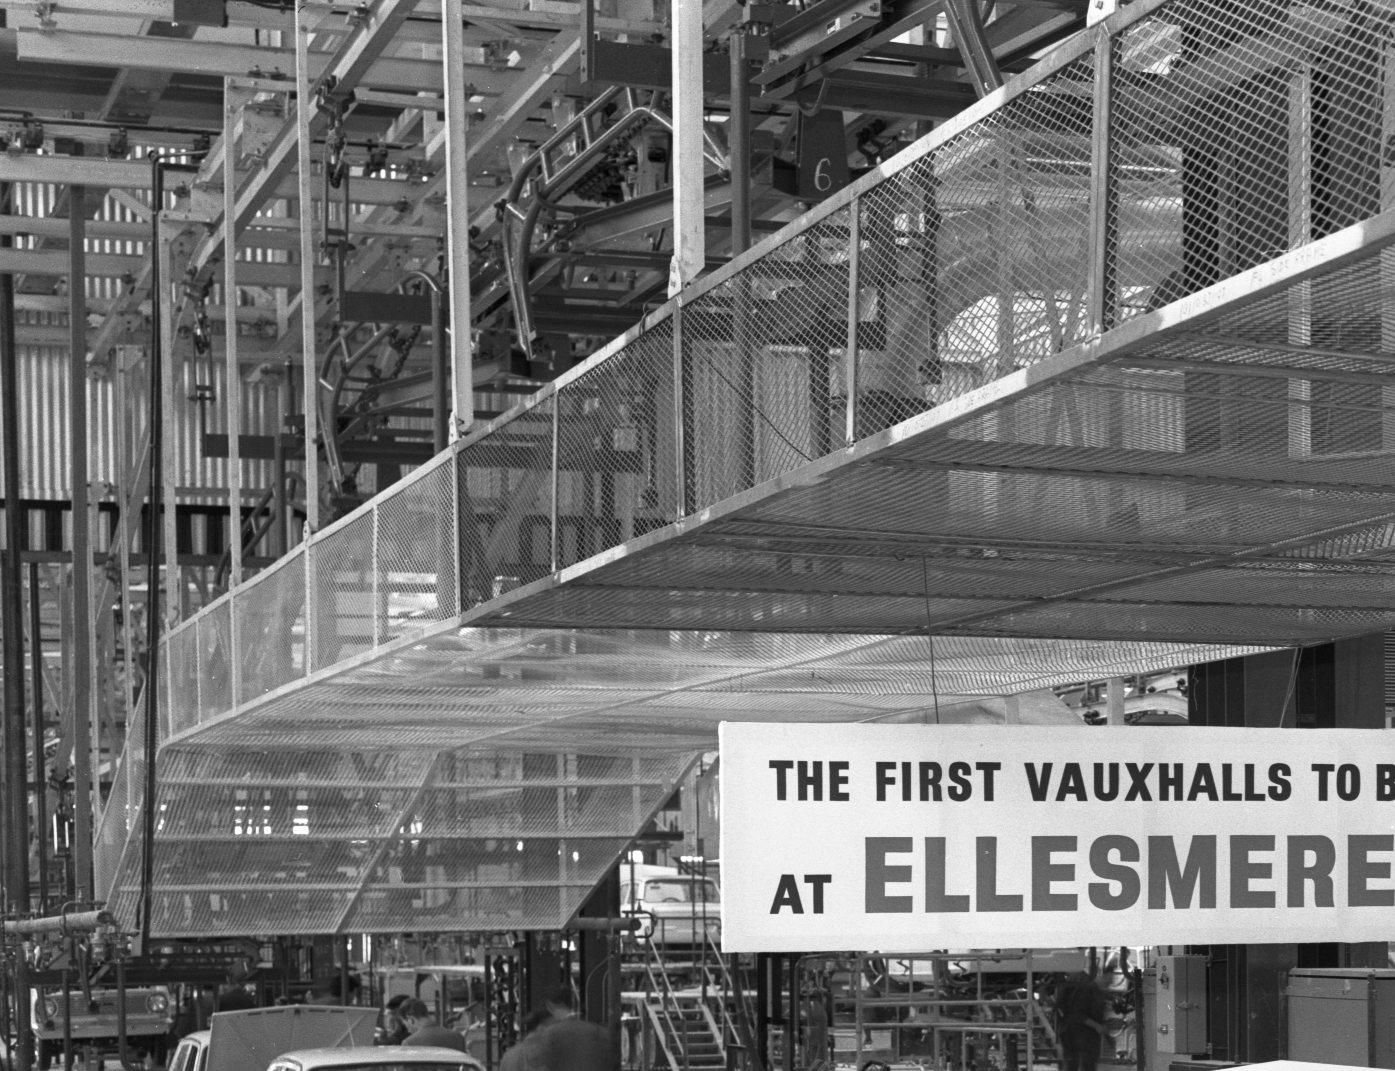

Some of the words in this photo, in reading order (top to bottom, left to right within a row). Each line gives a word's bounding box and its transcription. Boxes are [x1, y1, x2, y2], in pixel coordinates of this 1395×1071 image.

[814, 157, 832, 192] 6
[769, 760, 850, 802] THE
[875, 761, 1002, 802] FIRST
[1023, 763, 1292, 802] VAUXHALLS
[1311, 763, 1361, 802] TO
[769, 874, 832, 915] AT
[864, 834, 1395, 914] ELLESMERE
